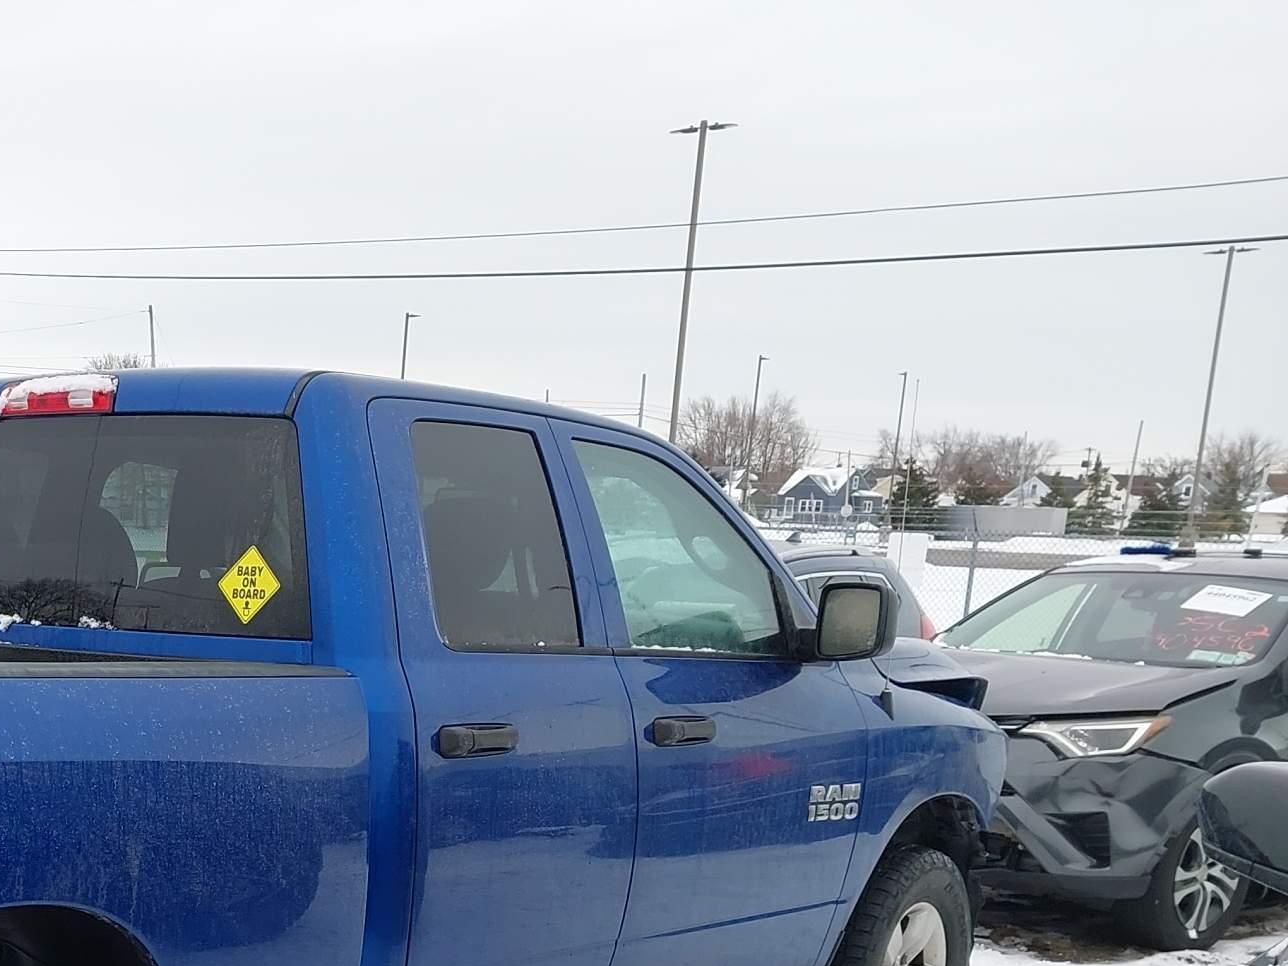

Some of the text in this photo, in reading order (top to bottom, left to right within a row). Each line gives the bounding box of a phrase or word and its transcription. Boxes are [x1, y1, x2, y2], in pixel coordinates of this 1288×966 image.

[237, 566, 264, 577] BABY
[242, 577, 257, 588] ON
[232, 588, 266, 599] BOARD
[809, 783, 861, 802] RAM
[808, 802, 859, 822] 1500
